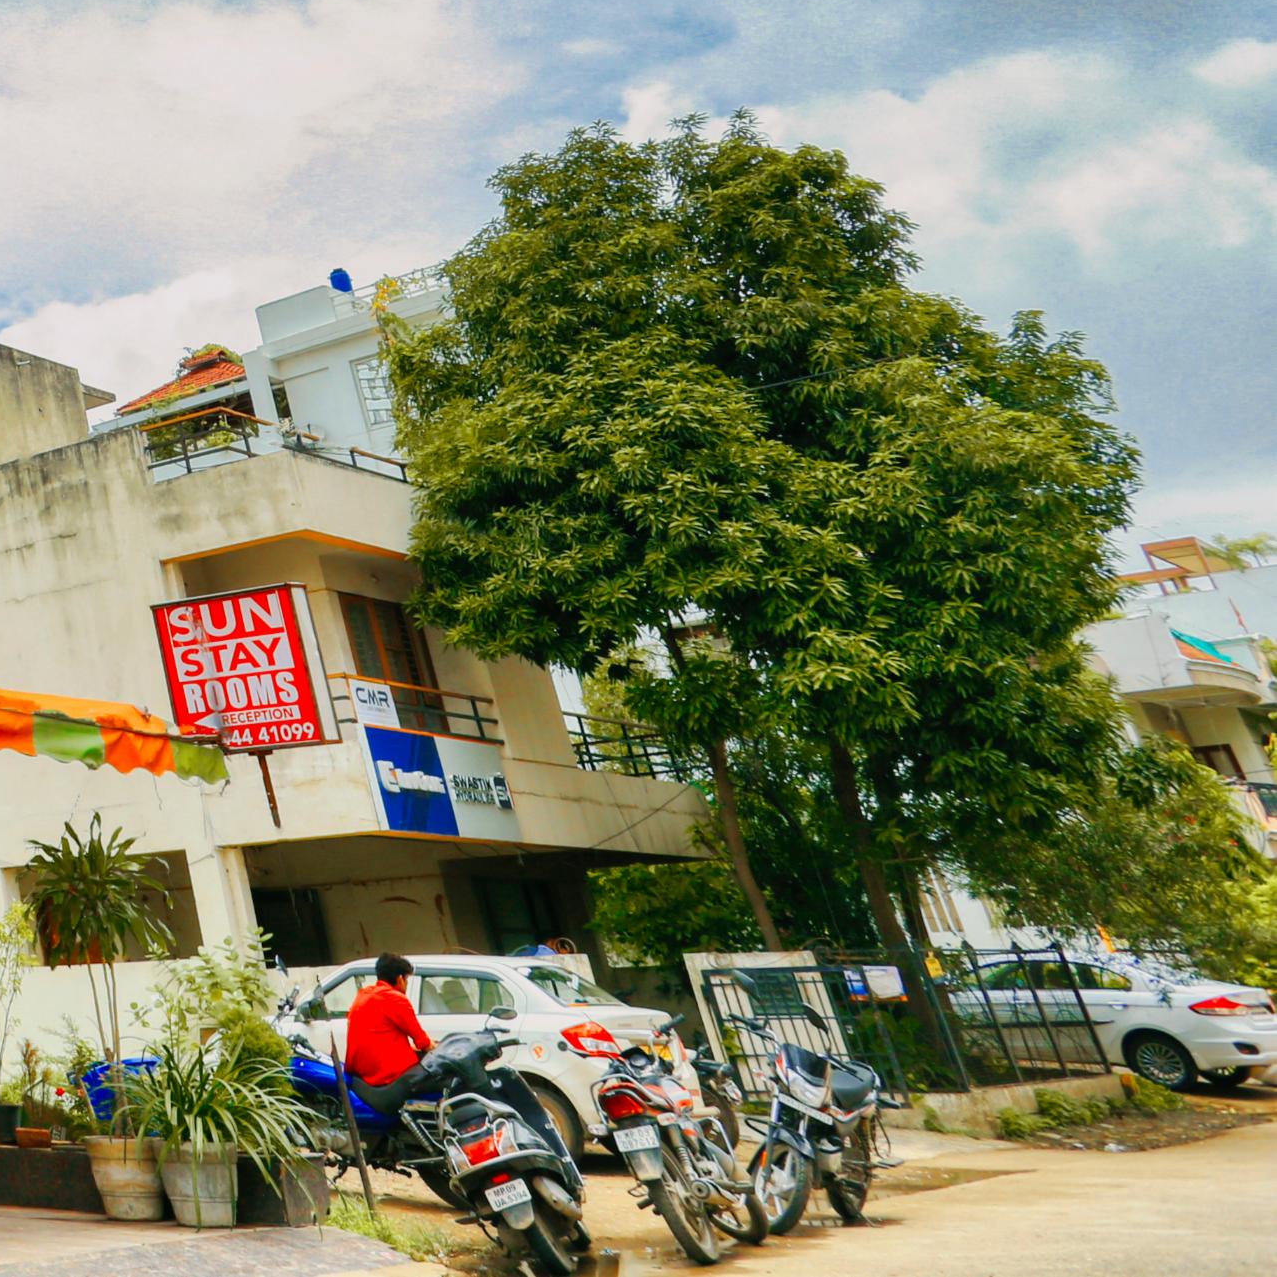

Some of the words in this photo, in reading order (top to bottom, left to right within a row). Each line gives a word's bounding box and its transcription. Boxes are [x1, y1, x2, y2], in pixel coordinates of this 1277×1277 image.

[168, 593, 284, 642] SUN
[180, 637, 282, 678] STAY
[182, 671, 299, 714] ROOMS
[355, 686, 390, 708] CMR
[222, 708, 294, 726] RECEPTION
[258, 722, 315, 742] 41099
[452, 775, 492, 791] SWASTIK
